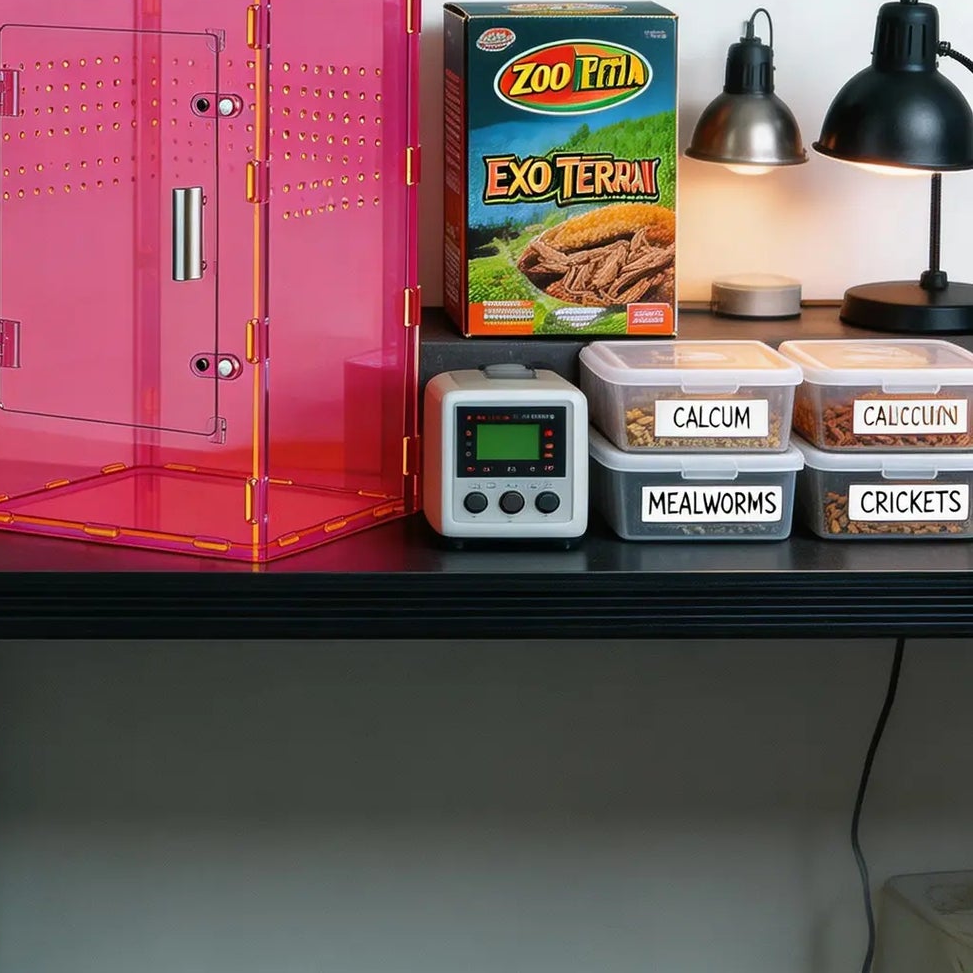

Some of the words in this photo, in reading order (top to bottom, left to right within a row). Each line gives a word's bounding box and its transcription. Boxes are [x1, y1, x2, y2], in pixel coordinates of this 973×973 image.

[509, 62, 573, 96] ZOO
[487, 158, 552, 196] EXO
[673, 405, 751, 429] CALCUM
[648, 491, 777, 515] MEALWORMS
[860, 489, 962, 515] CRICKETS
